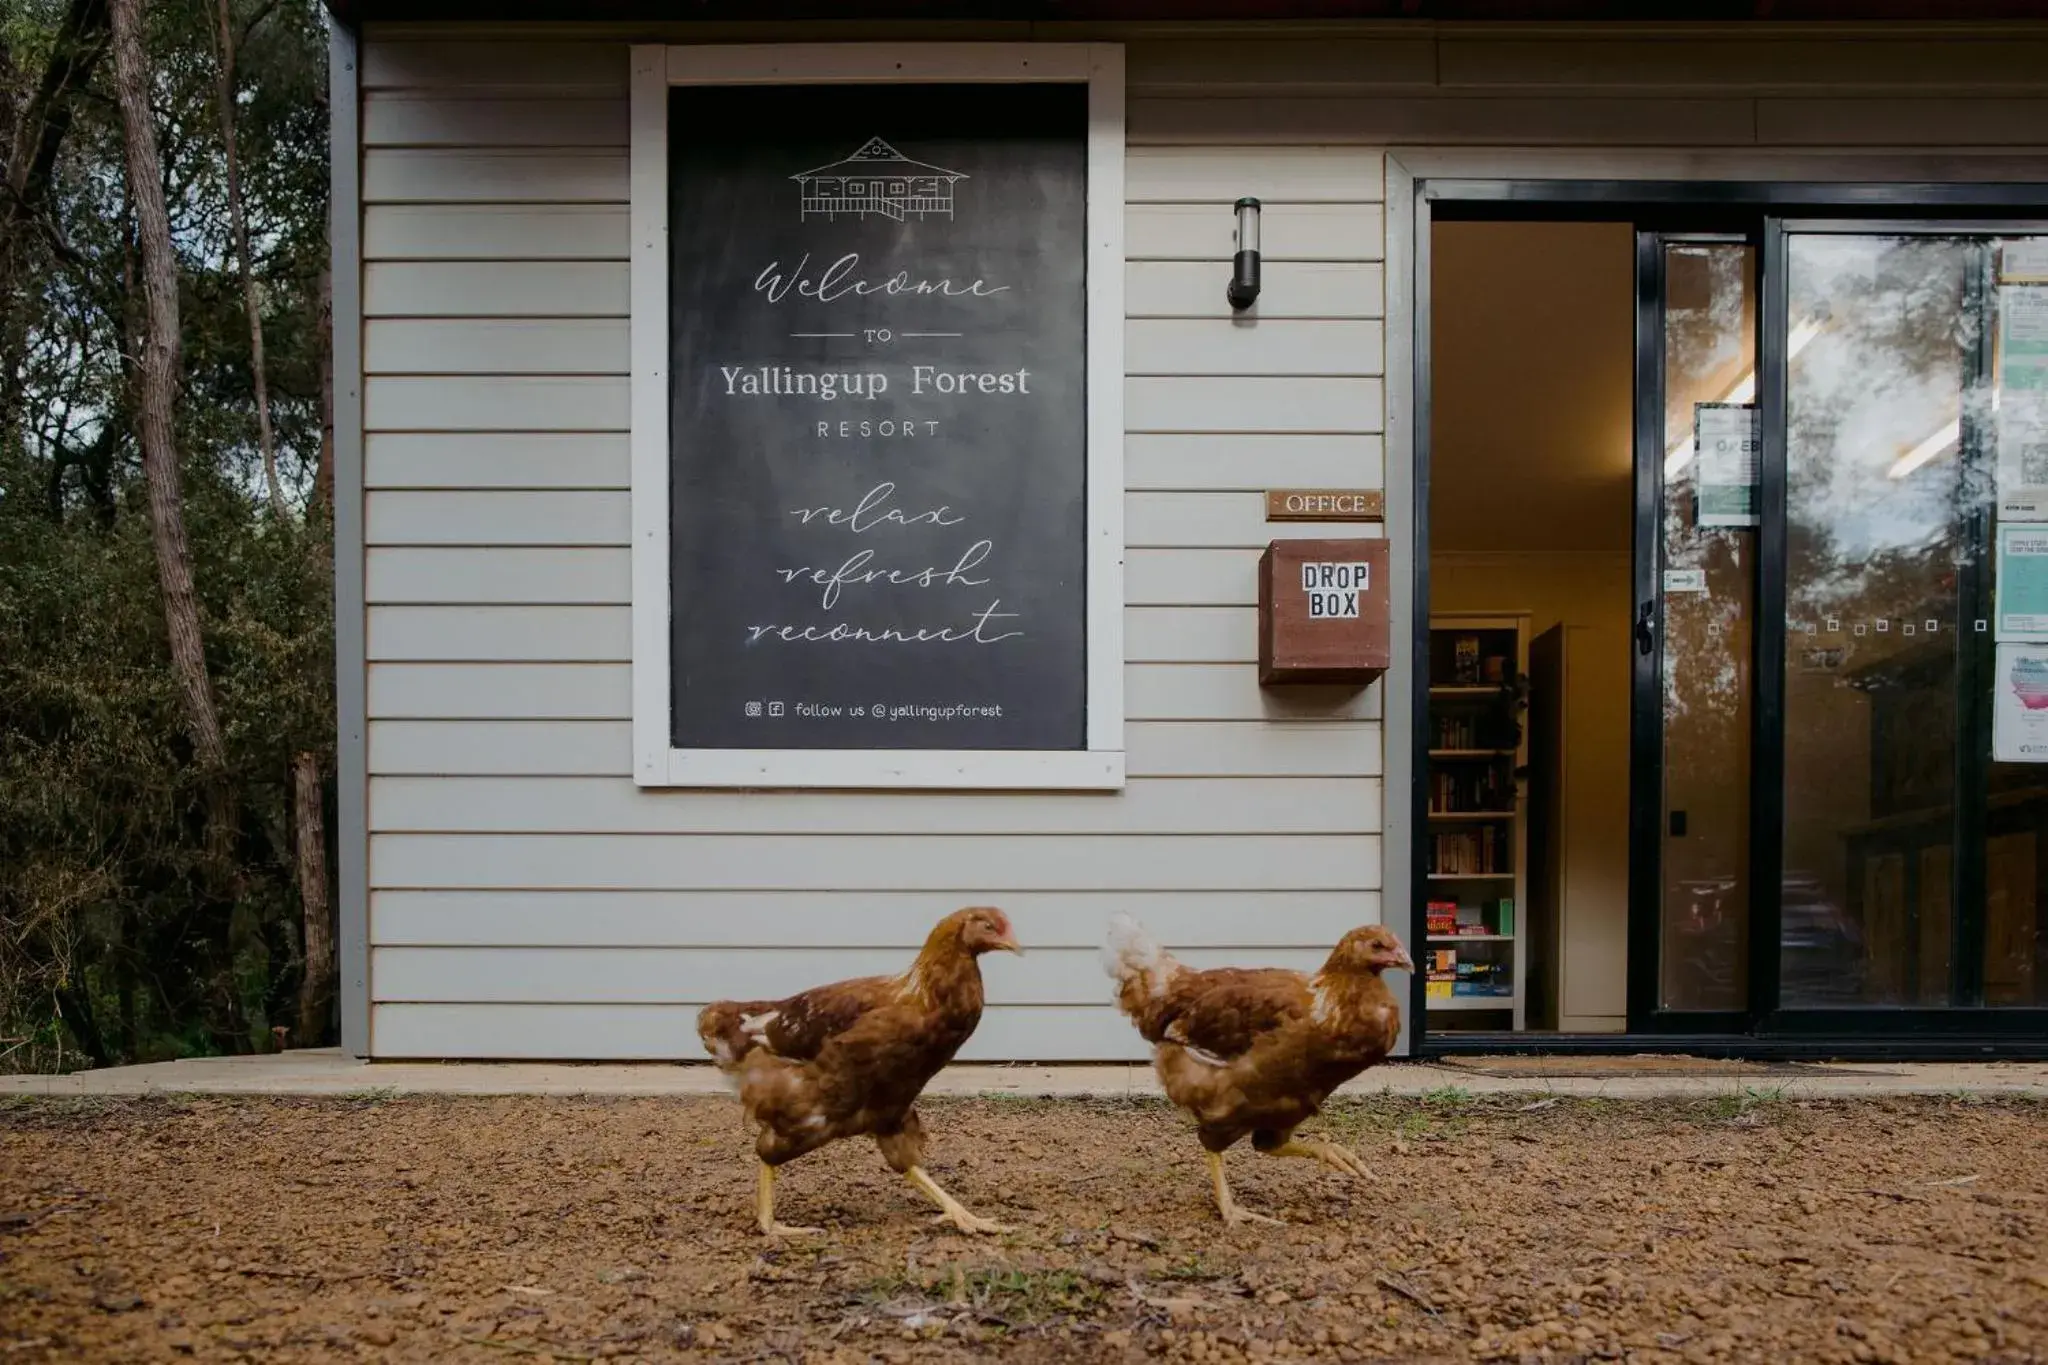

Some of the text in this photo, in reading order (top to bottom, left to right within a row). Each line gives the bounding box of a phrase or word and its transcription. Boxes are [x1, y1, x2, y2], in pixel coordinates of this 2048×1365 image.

[754, 253, 1011, 303] Welcome
[863, 328, 892, 343] TO
[720, 365, 1032, 401] Yallingup Forest
[817, 420, 940, 438] RESORT
[790, 482, 966, 533] relax
[1285, 494, 1366, 513] OFFICE
[776, 540, 992, 610] refresh
[1304, 565, 1367, 589] DROP
[1311, 592, 1357, 617] BOX
[747, 599, 1025, 644] reconnect
[794, 702, 843, 718] follow
[849, 706, 866, 718] us
